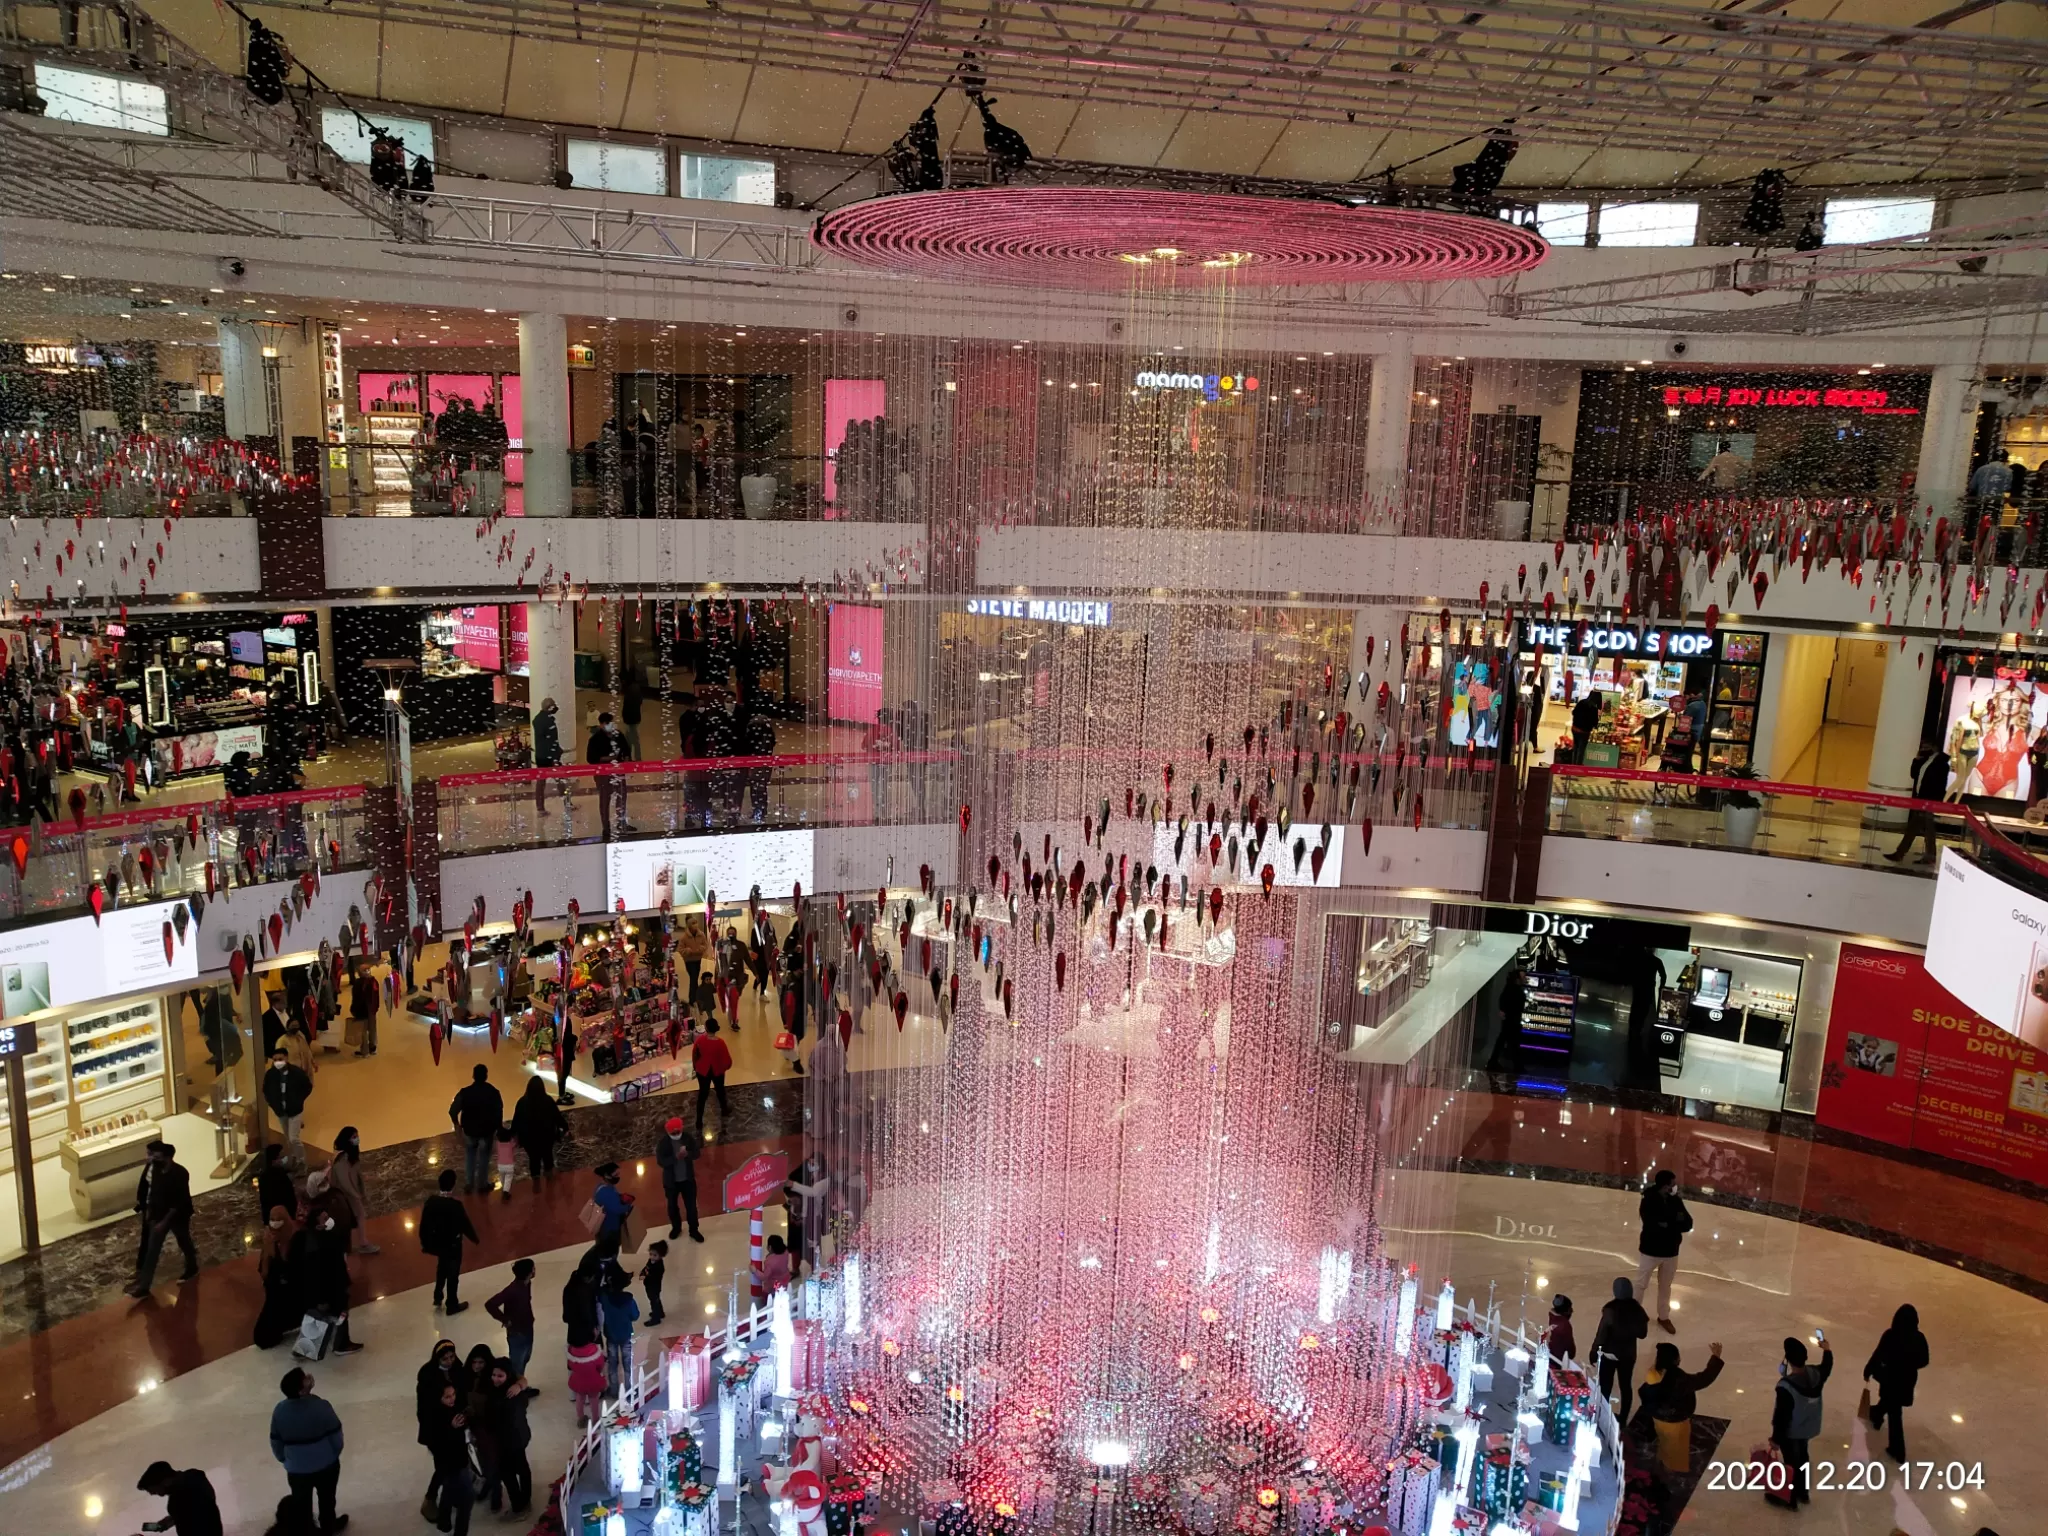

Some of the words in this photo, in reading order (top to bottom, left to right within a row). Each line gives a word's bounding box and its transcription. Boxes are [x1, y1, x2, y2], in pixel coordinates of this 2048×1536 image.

[25, 346, 77, 364] SATTVIK
[967, 600, 1024, 618] STEVE
[1029, 600, 1109, 627] MADDEN
[1527, 625, 1570, 647] THE
[1524, 911, 1593, 939] Dior
[2011, 908, 2046, 936] Galaxy
[1911, 1008, 1972, 1034] SHOE
[1966, 1037, 2036, 1066] DRIVE
[1919, 1095, 2005, 1125] DECEMBER
[1938, 1128, 1961, 1140] CITY
